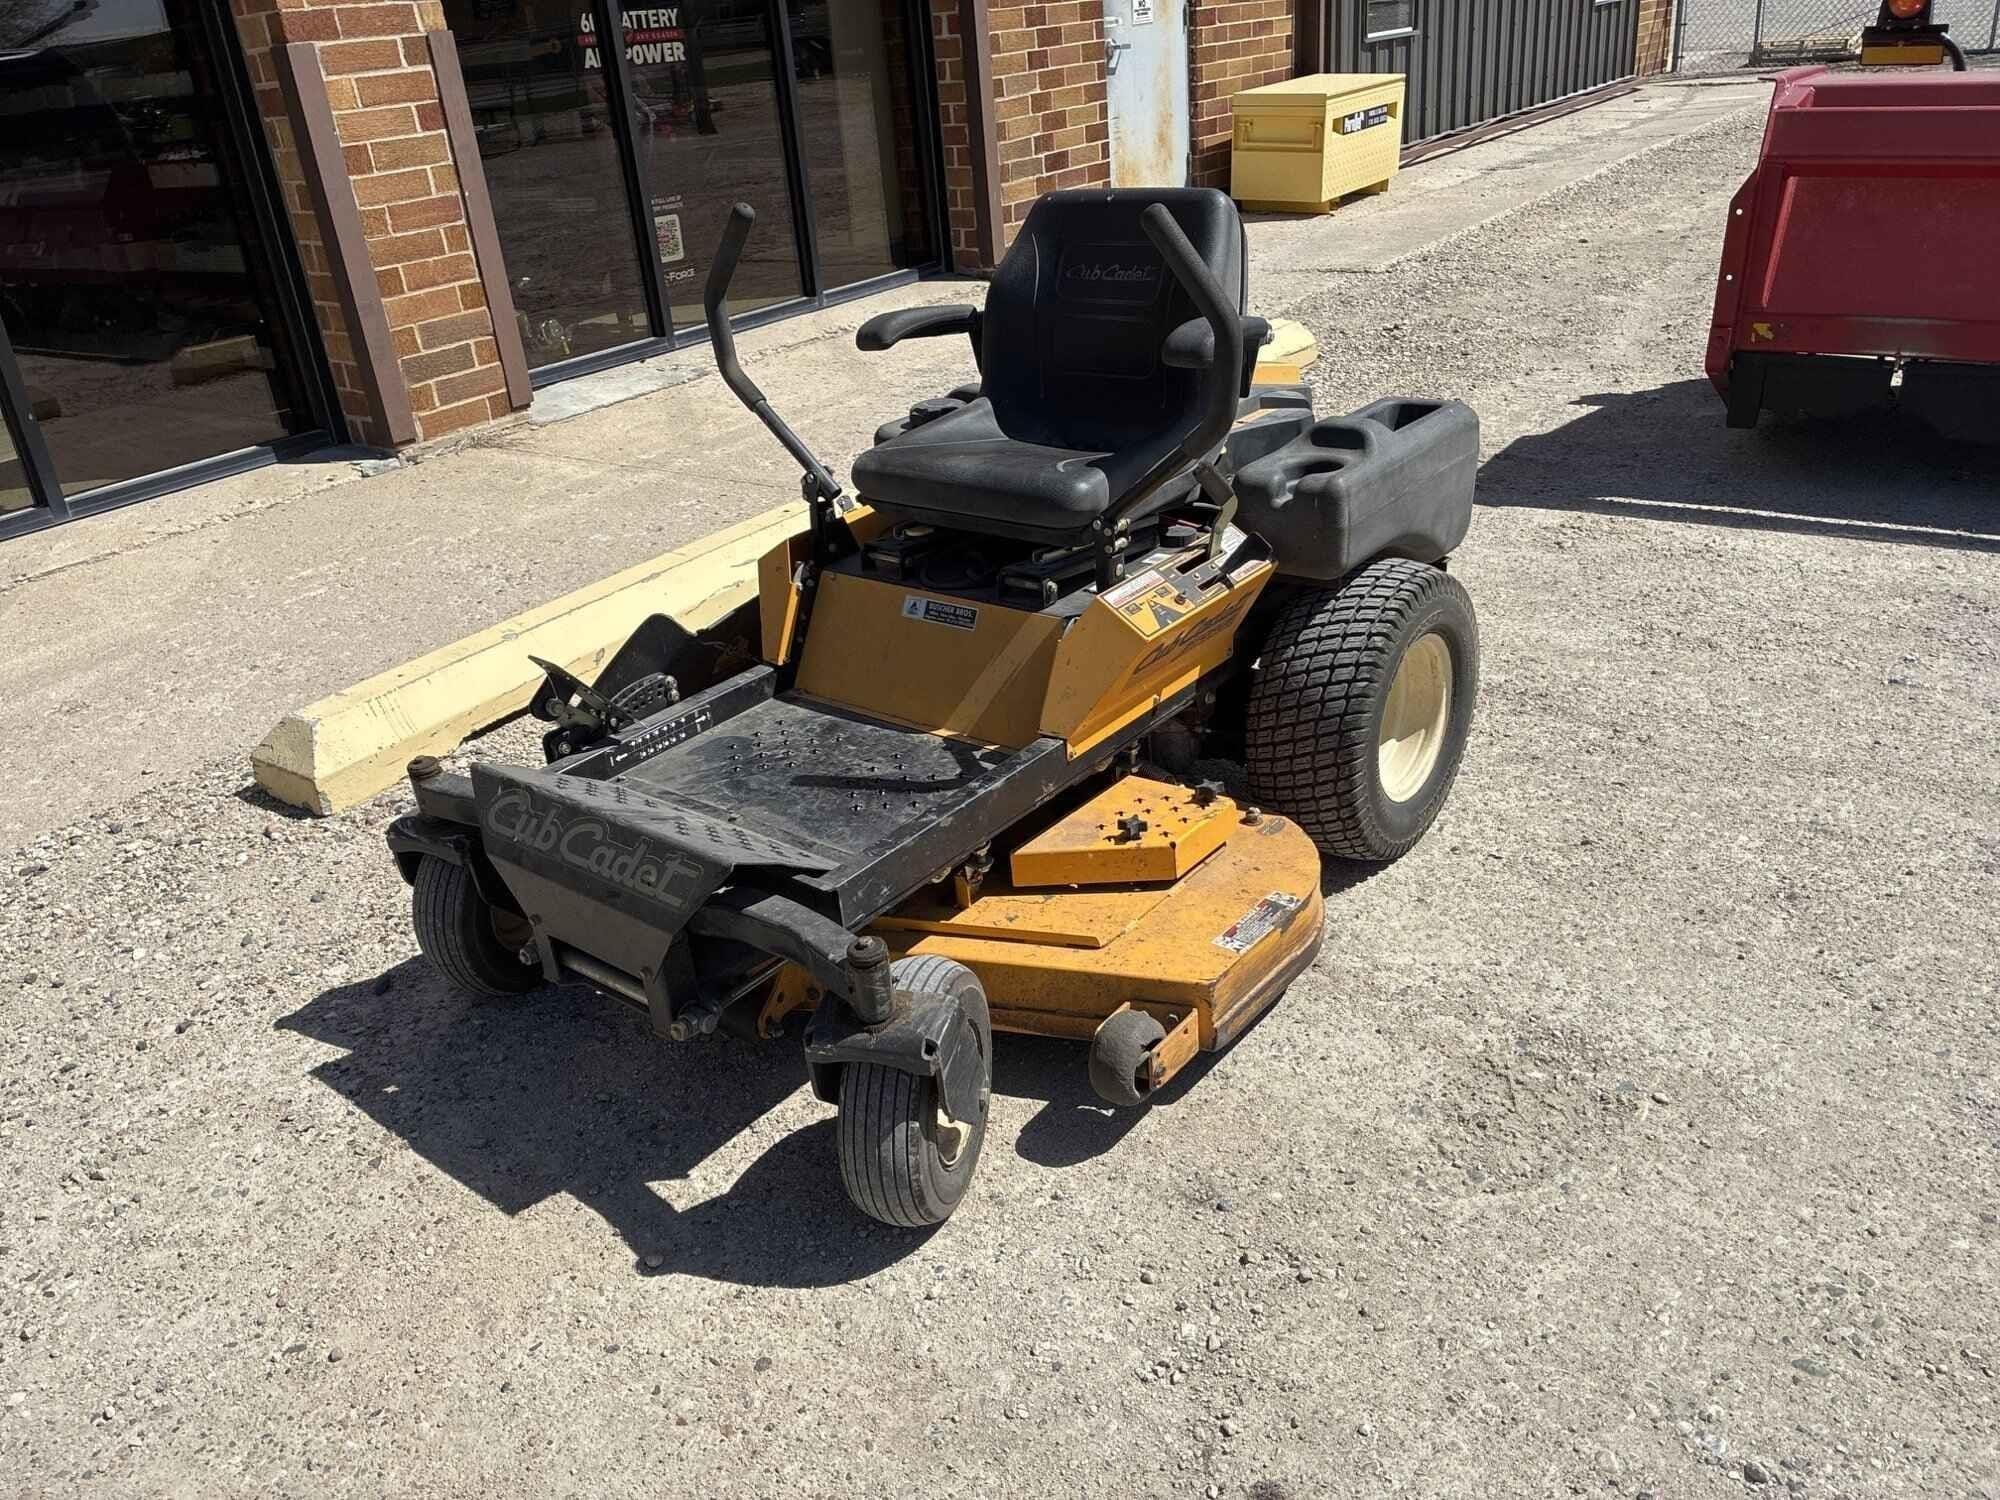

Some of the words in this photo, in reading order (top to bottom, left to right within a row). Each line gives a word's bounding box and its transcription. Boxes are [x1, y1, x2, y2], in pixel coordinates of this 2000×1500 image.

[622, 8, 678, 29] ATTERY
[484, 788, 561, 853] Cub
[559, 819, 702, 910] Cadet
